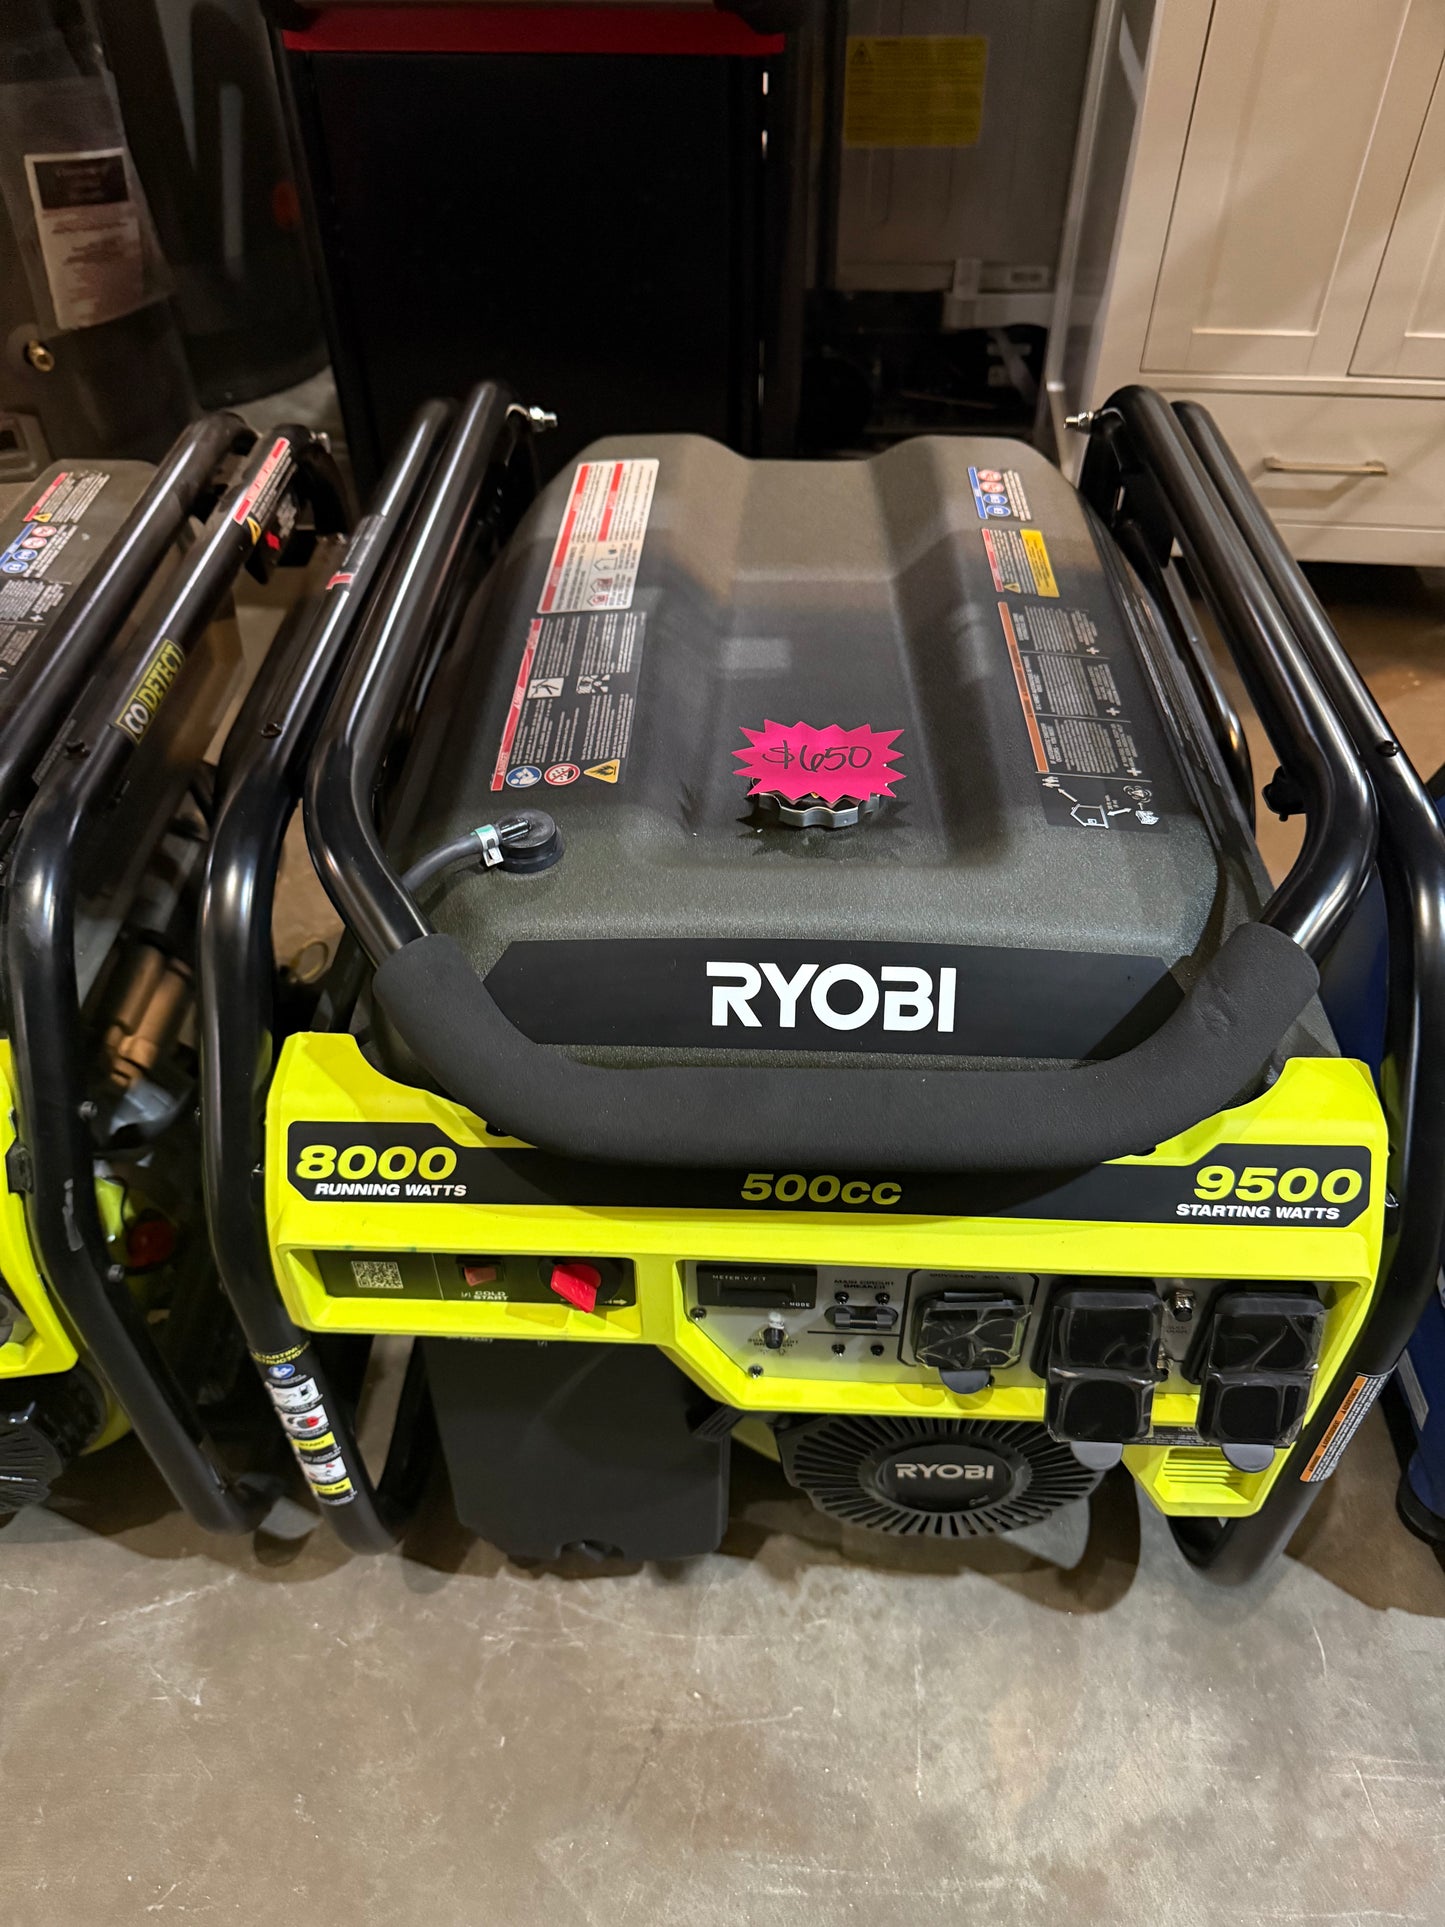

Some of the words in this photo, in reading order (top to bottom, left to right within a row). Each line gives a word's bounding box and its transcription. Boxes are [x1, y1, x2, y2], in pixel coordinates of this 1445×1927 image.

[138, 643, 183, 713] DETECT
[761, 739, 873, 773] $650
[706, 961, 957, 1033] RYOBI
[295, 1144, 458, 1181] 8000
[314, 1183, 400, 1196] RUNNING
[405, 1184, 467, 1197] WATTS
[740, 1173, 902, 1205] 500cc
[1193, 1165, 1363, 1204] 9500
[1175, 1203, 1271, 1218] STARTING
[1275, 1206, 1340, 1220] WATTS
[895, 1463, 994, 1480] RYOBI
